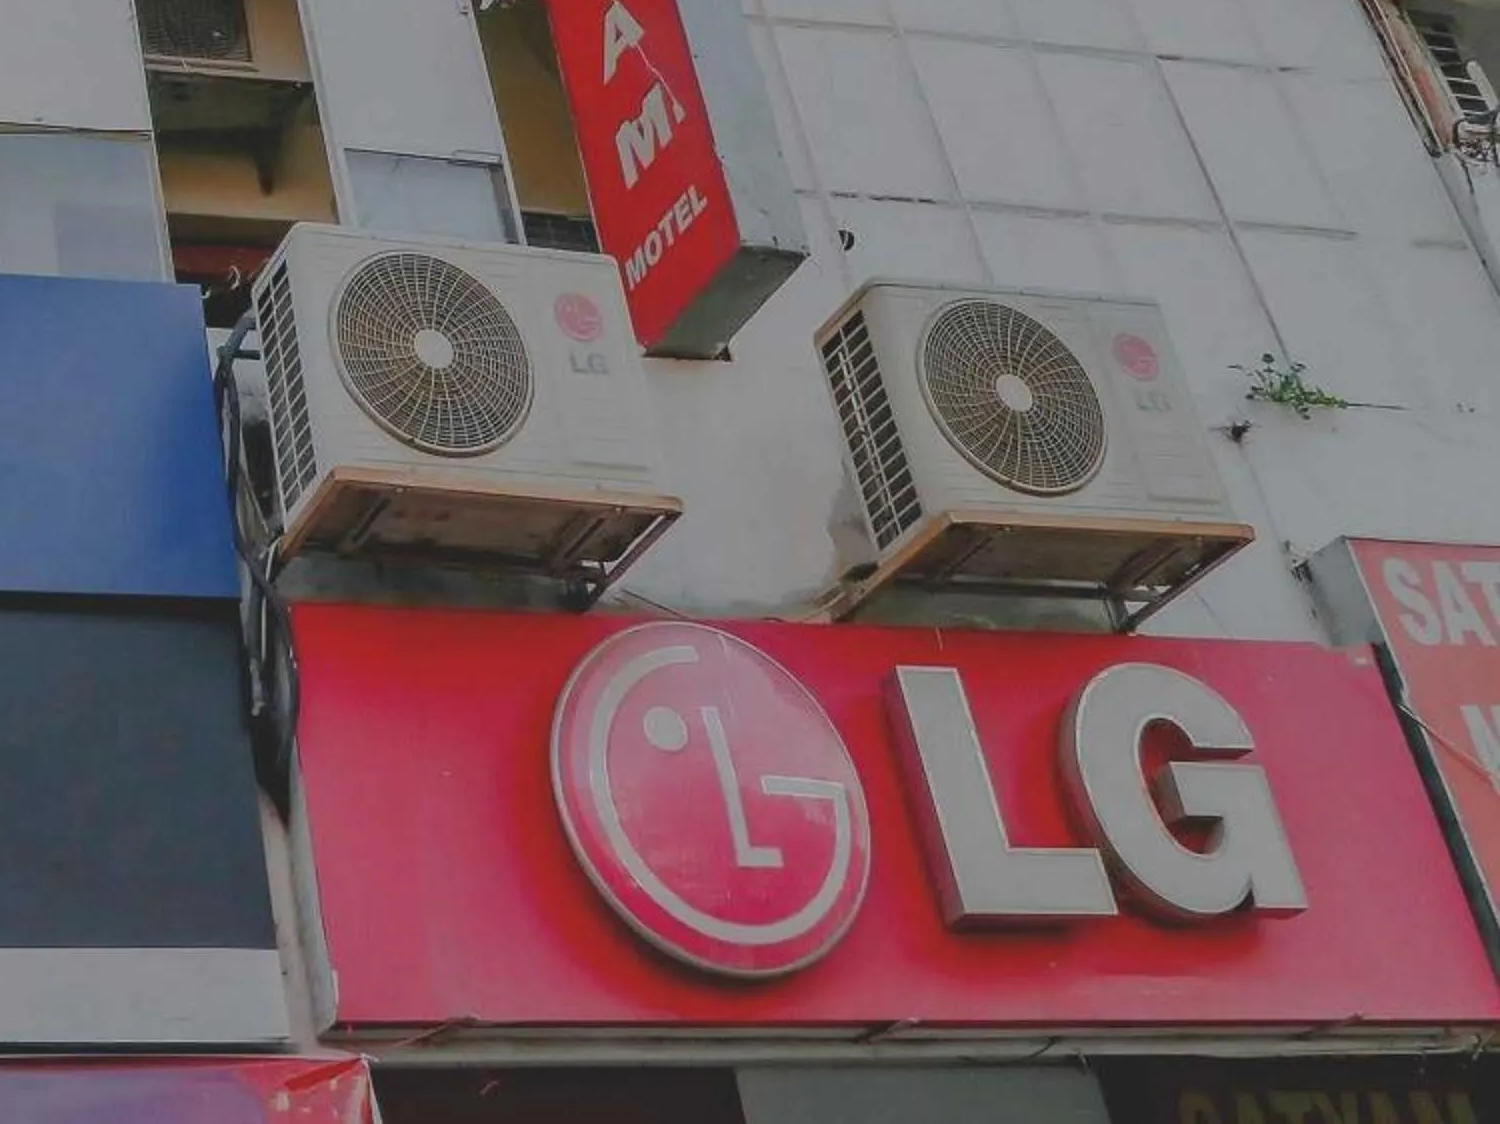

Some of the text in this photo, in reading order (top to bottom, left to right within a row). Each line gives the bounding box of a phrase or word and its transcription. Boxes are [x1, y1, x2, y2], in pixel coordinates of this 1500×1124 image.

[625, 184, 708, 291] MOTEL
[567, 350, 609, 375] LG
[891, 661, 1308, 922] LG
